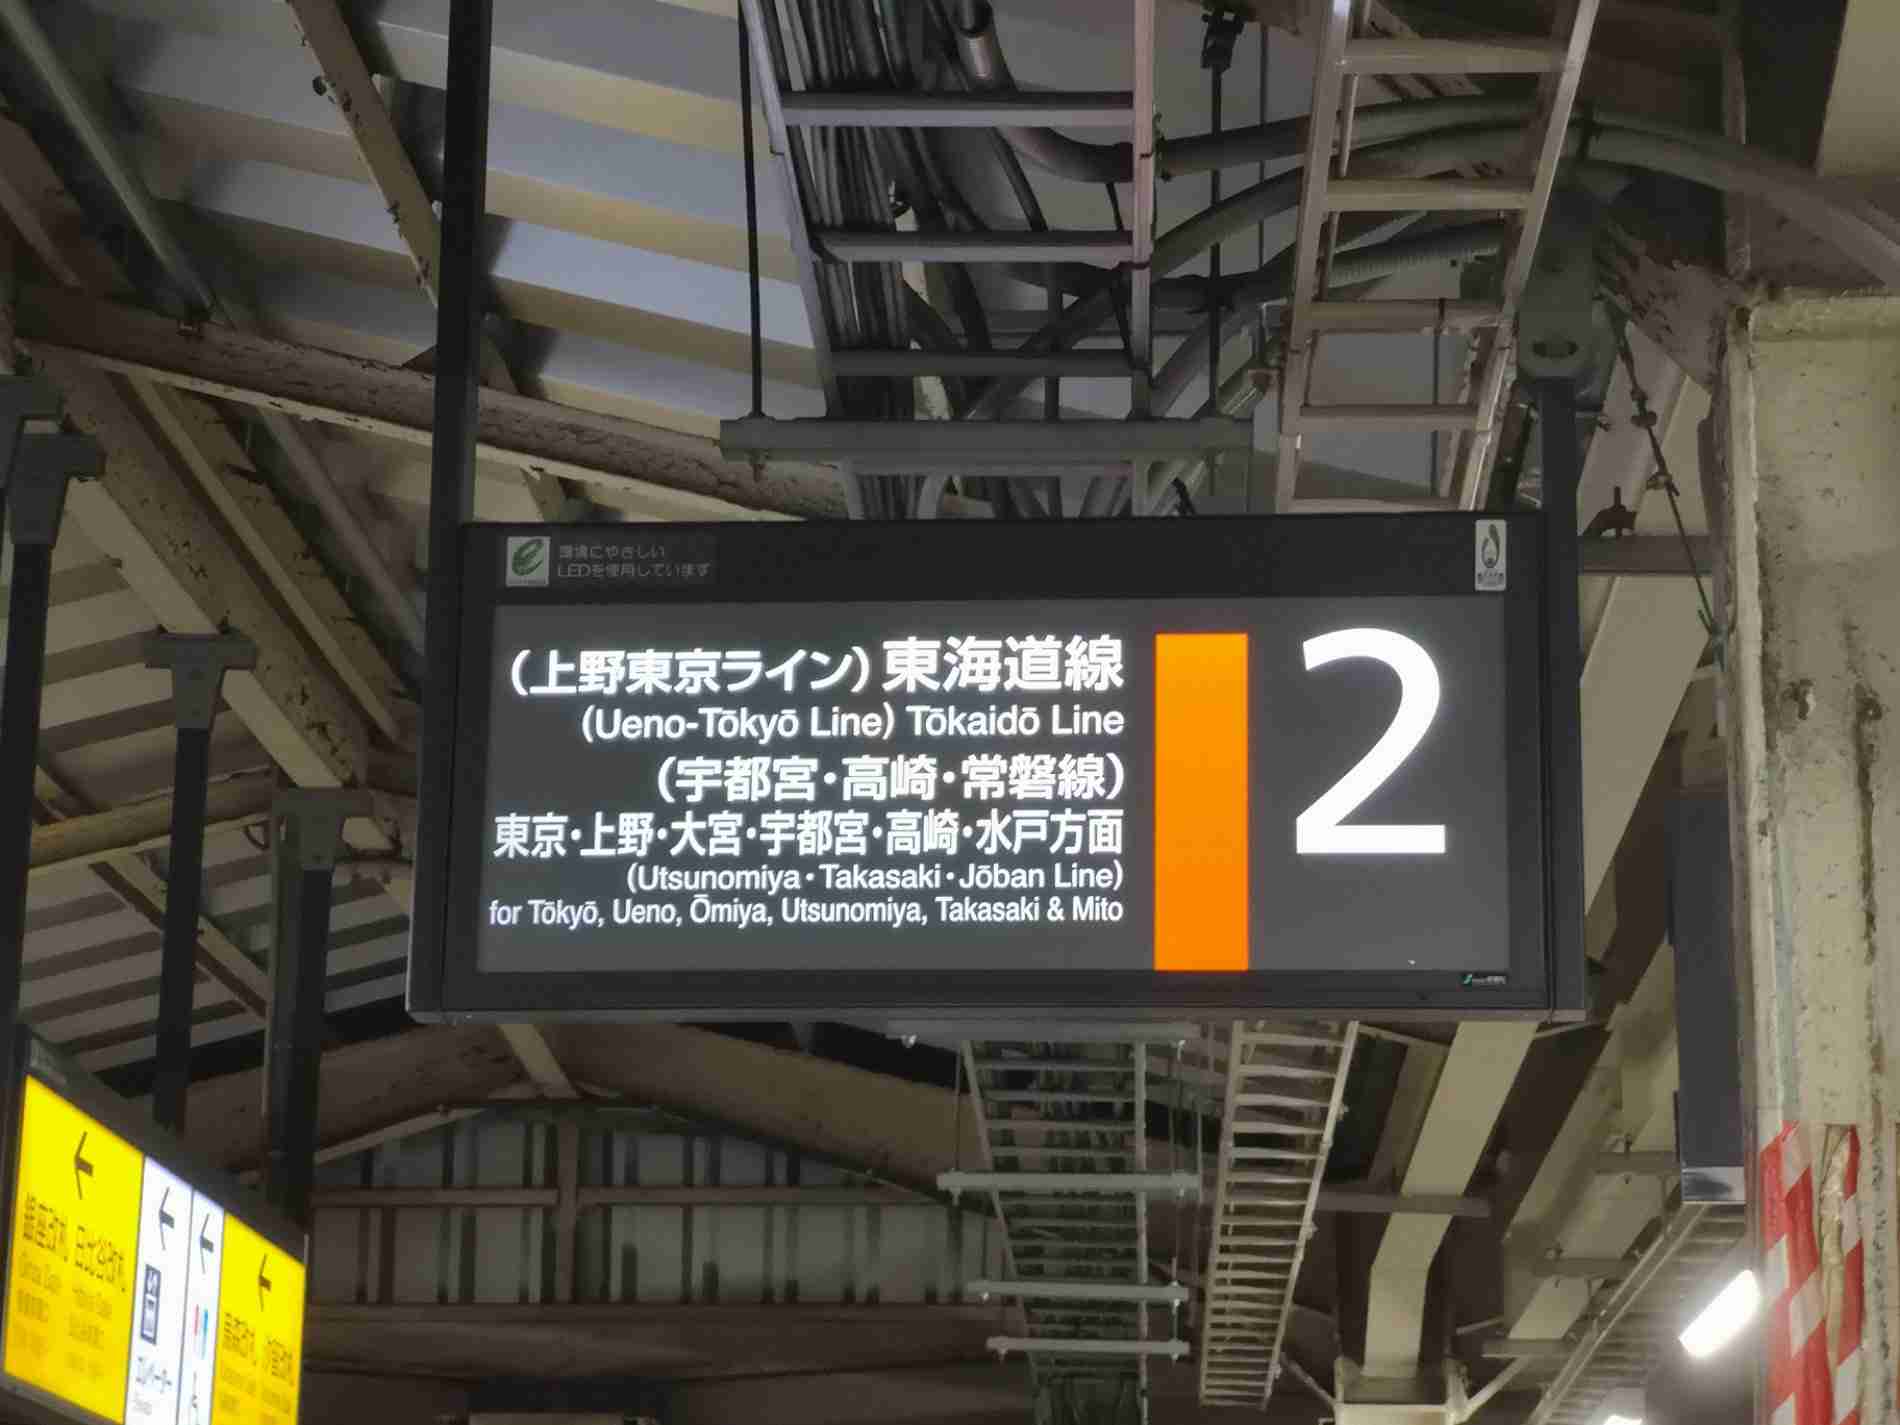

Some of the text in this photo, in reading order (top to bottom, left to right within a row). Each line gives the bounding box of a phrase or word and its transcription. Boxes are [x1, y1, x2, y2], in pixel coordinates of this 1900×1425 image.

[511, 634, 1125, 697] (上野東京ライン) 東海道線
[582, 702, 1125, 745] (Ueno-Tōkyō Line) Tōkaidō Line
[1296, 628, 1447, 855] 2
[1055, 859, 1124, 892] Line)
[489, 894, 1124, 930] for Tōkyō, Ueno, Ōmiya, Utsunomiya, Takasaki & Mito
